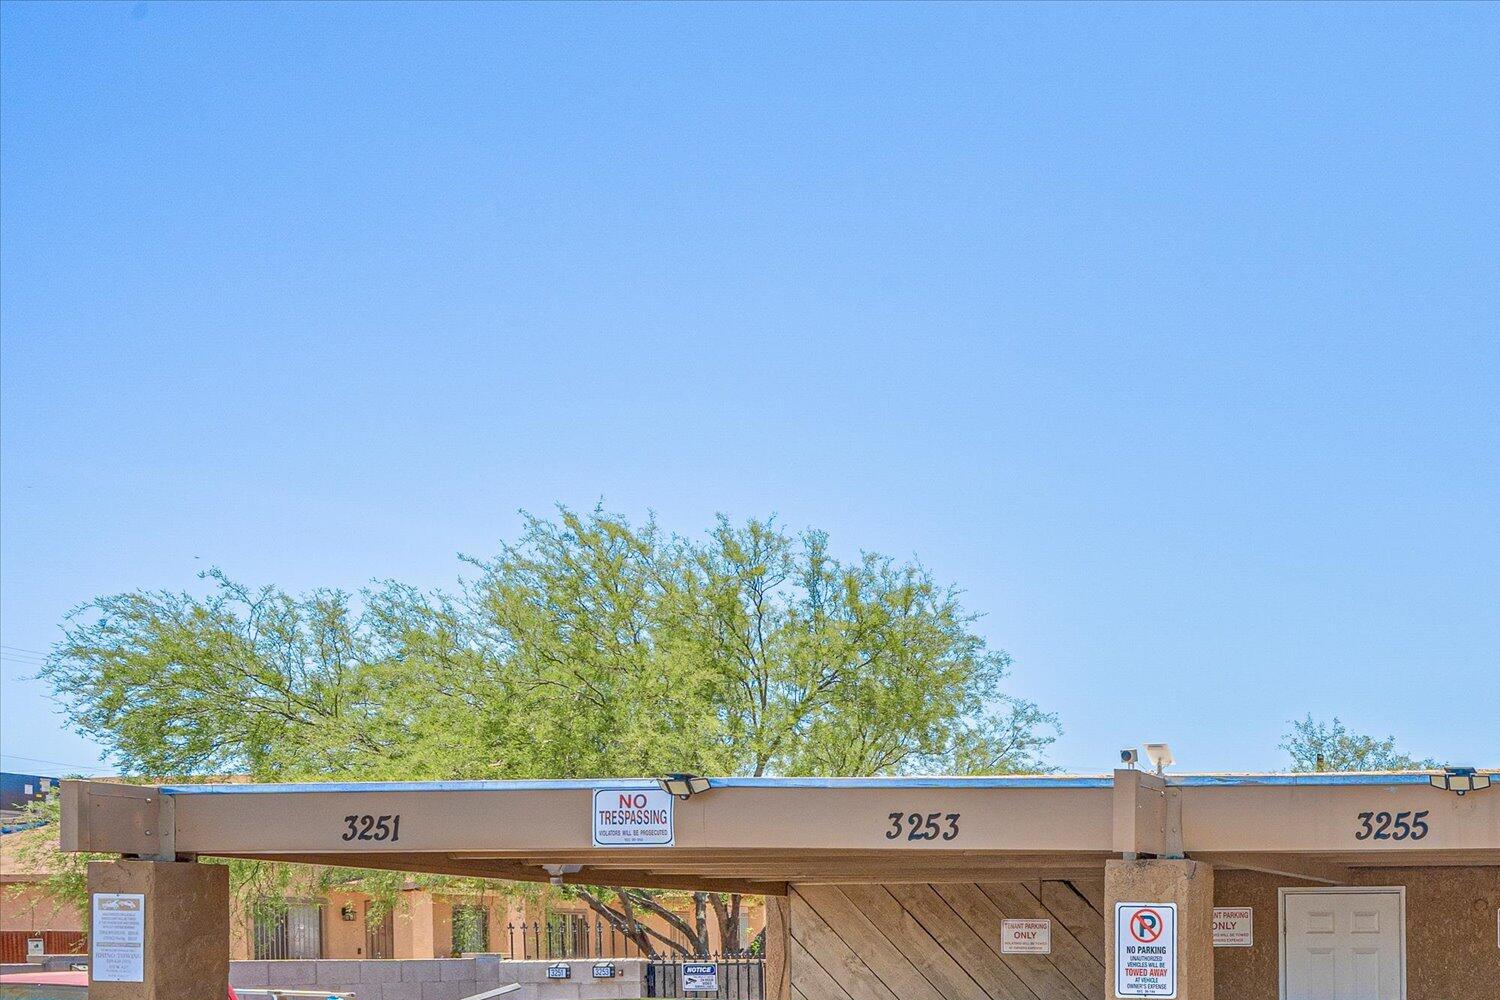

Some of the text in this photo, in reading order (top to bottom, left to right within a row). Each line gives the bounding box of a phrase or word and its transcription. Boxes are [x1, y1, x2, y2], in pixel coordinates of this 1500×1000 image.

[619, 794, 647, 809] NO
[599, 810, 668, 825] TRESPASSING
[1355, 810, 1429, 840] 3255
[342, 814, 400, 842] 3251
[886, 812, 960, 841] 3253
[1212, 922, 1236, 930] ONLY
[1014, 932, 1037, 940] ONLY
[1126, 946, 1166, 954] NO PARKING
[1125, 968, 1168, 976] TOWED AWAY
